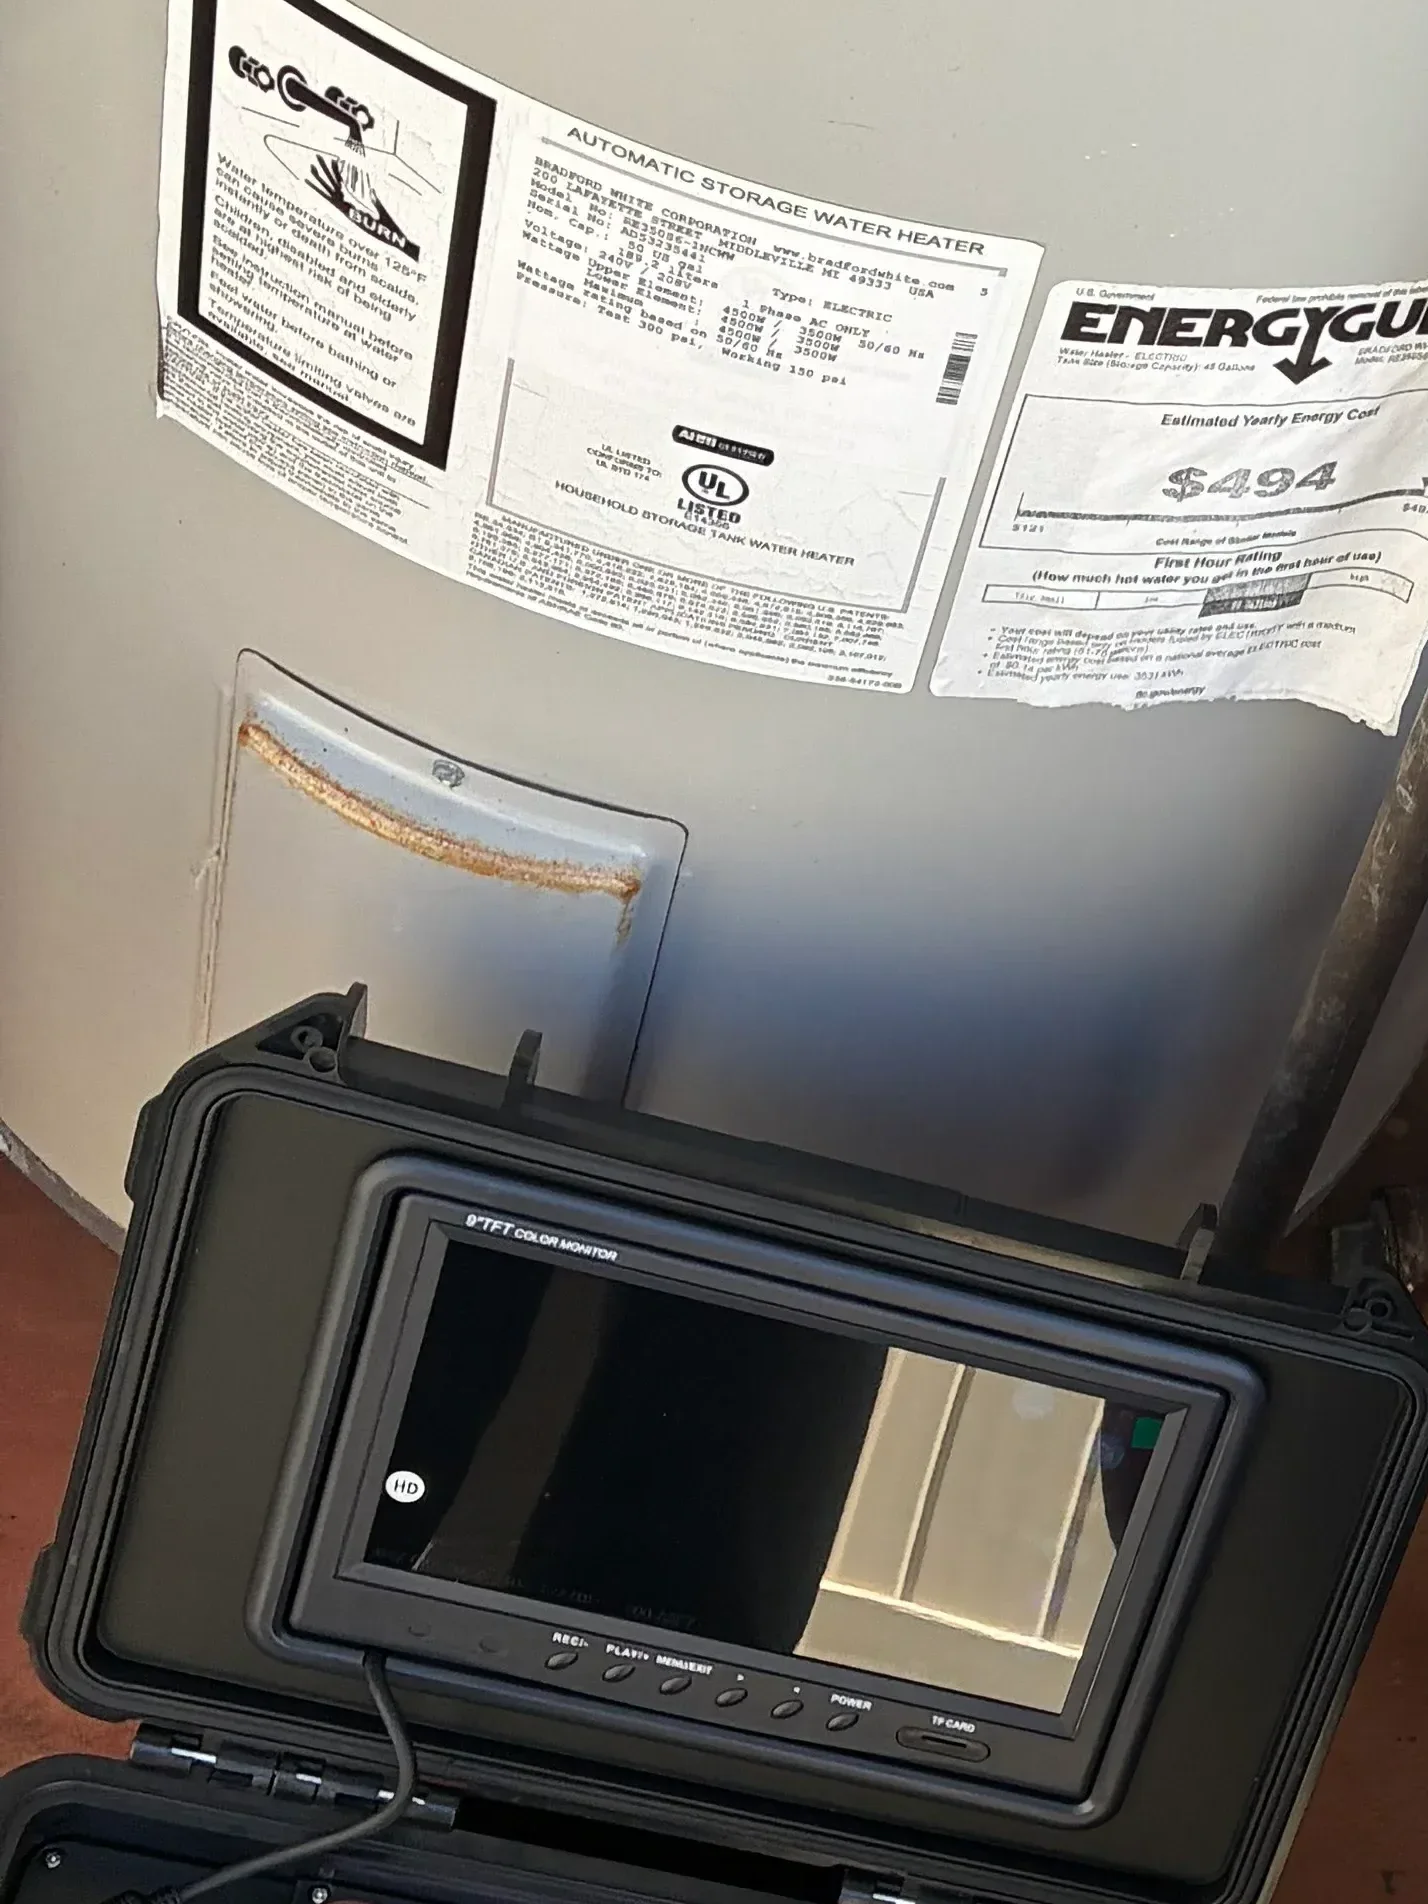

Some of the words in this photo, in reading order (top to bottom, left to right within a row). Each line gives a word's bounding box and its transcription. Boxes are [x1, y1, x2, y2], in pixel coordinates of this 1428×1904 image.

[217, 152, 257, 184] Water
[262, 183, 344, 240] temperature
[535, 156, 602, 191] BRADFORD
[610, 188, 654, 211] WHITE
[661, 208, 757, 246] CORPORATION
[567, 126, 695, 184] AUTOMATIC
[701, 176, 808, 220] STORAGE
[813, 208, 893, 239] WATER
[897, 228, 985, 256] HEATER
[349, 208, 407, 249] BURN
[533, 167, 558, 185] 200
[566, 182, 644, 219] LAFAYETTE
[718, 239, 815, 273] MIDDLEVILLE
[821, 267, 840, 279] MI
[823, 300, 893, 322] ELECTRIC
[1242, 414, 1288, 428] Yearly
[1291, 411, 1344, 426] Energy
[1347, 406, 1381, 421] Cost
[699, 471, 730, 500] UL
[1162, 460, 1338, 502] $494
[555, 480, 639, 516] HOUSEHOLD
[711, 528, 747, 546] TANK
[749, 539, 798, 557] WATER
[677, 497, 741, 524] LISTED
[514, 1227, 559, 1249] COLOR
[558, 1238, 618, 1262] MONITOR
[393, 1478, 419, 1496] HD
[829, 1692, 872, 1712] POWER
[945, 1716, 976, 1734] CARD
